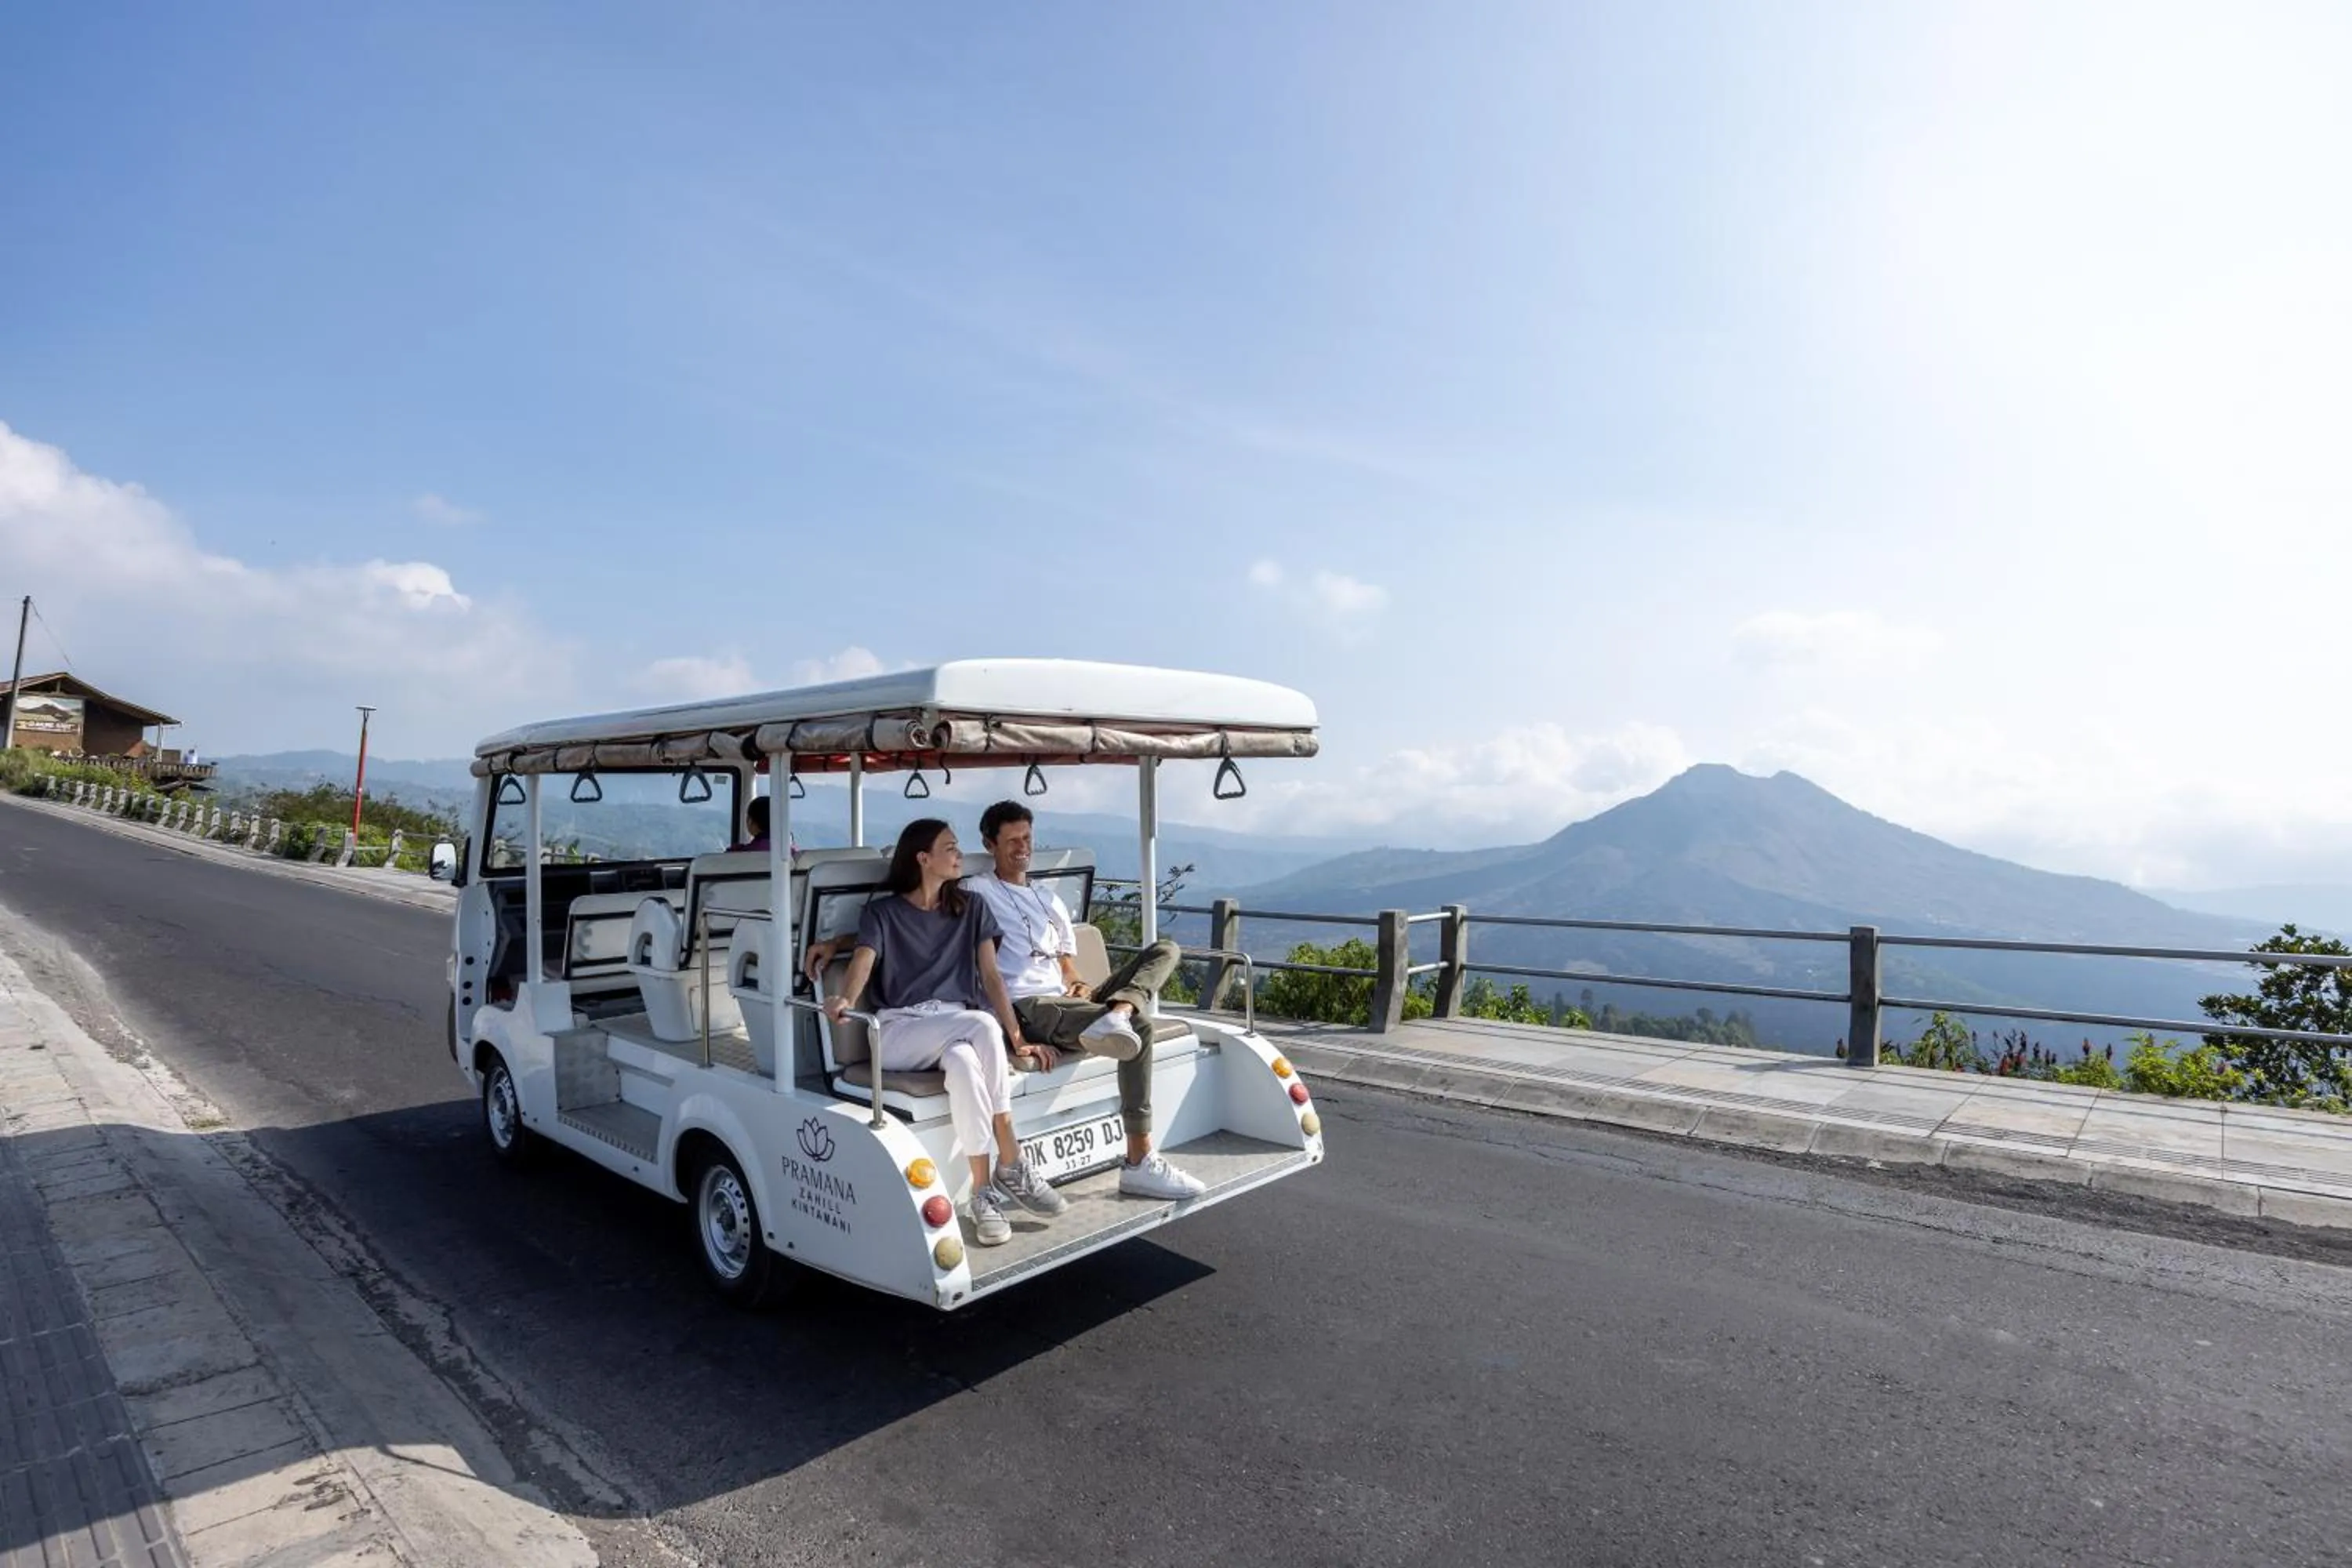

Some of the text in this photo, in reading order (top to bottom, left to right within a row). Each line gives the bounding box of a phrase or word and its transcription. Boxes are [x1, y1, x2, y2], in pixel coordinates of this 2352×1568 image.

[1023, 1119, 1123, 1167] DK 8259 DJ
[782, 1156, 857, 1205] PRAMANA
[799, 1187, 841, 1214] ZAHILL
[791, 1198, 851, 1234] KINTAMANI
